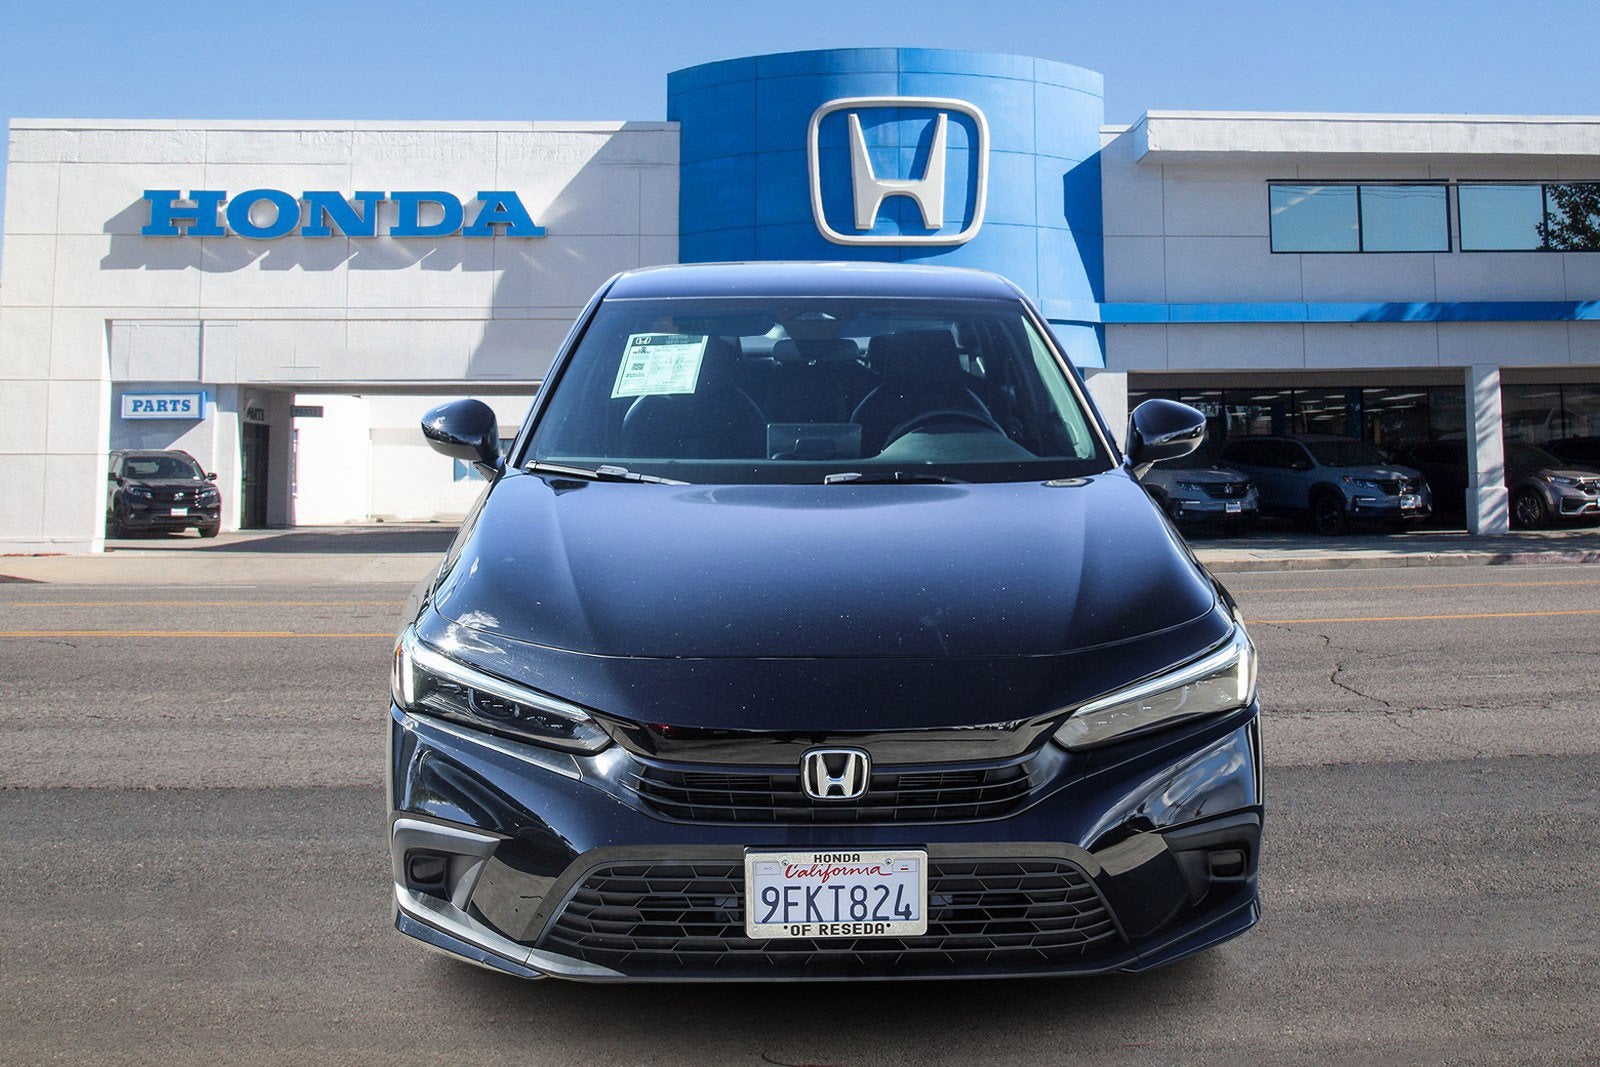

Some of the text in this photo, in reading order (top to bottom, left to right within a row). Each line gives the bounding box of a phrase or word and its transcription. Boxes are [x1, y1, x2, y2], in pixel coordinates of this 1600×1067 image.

[141, 188, 548, 240] HONDA
[132, 399, 191, 413] PARTS
[814, 853, 861, 863] HONDA
[785, 863, 893, 884] California
[761, 884, 913, 924] 9FKT824
[790, 923, 885, 936] OF RESEDA
